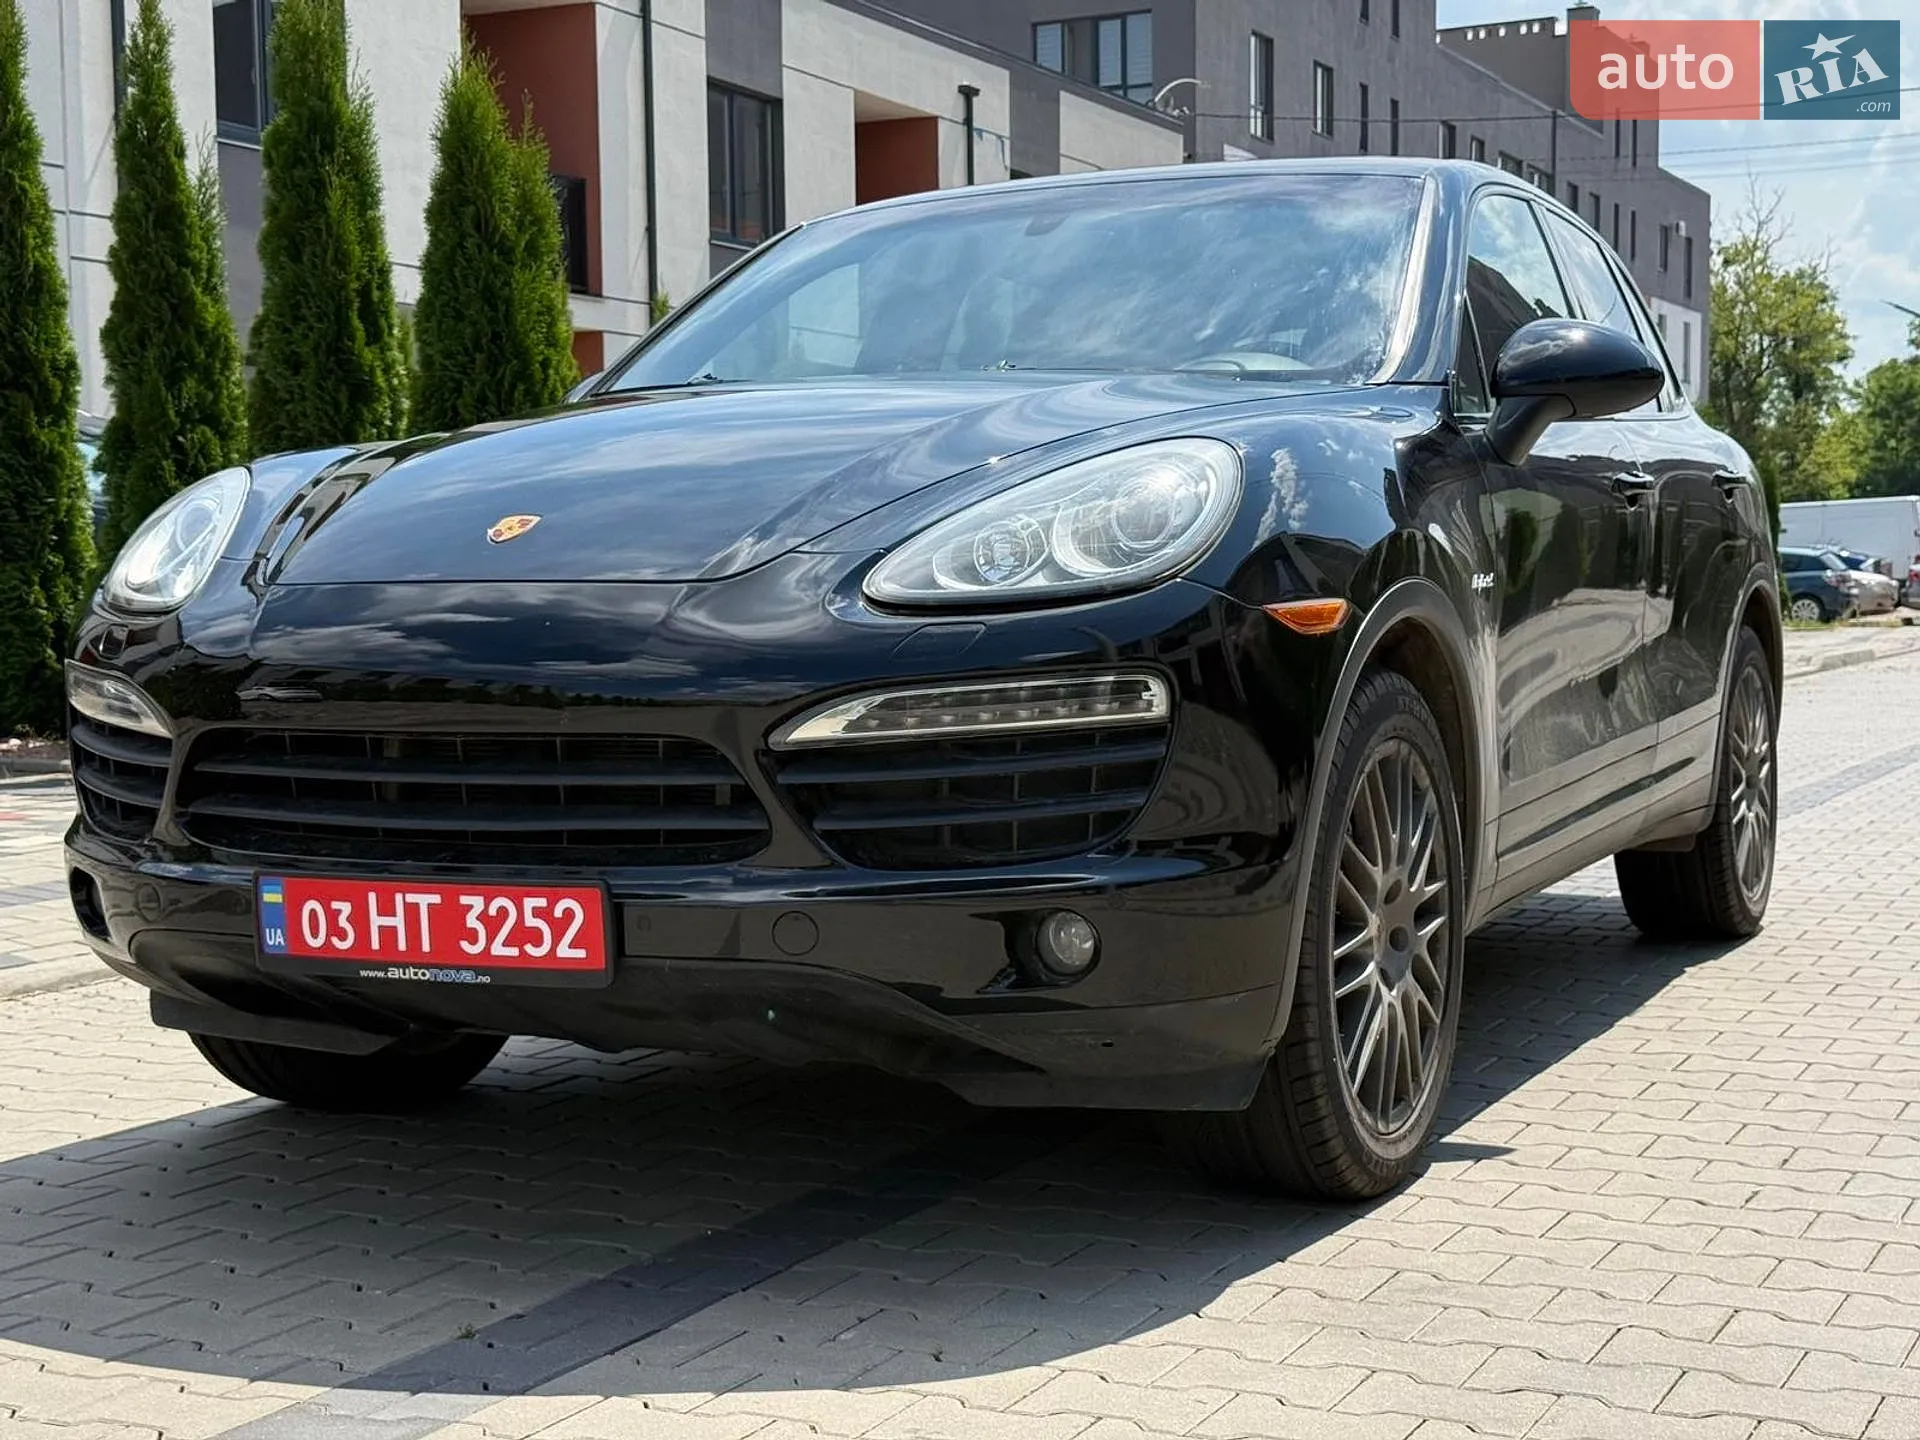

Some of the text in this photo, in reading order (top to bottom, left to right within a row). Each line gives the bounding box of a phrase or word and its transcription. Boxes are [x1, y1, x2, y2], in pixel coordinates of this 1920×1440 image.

[301, 891, 587, 958] 03 HT 3252
[265, 927, 285, 946] UA
[359, 966, 491, 984] www.autonova.no
